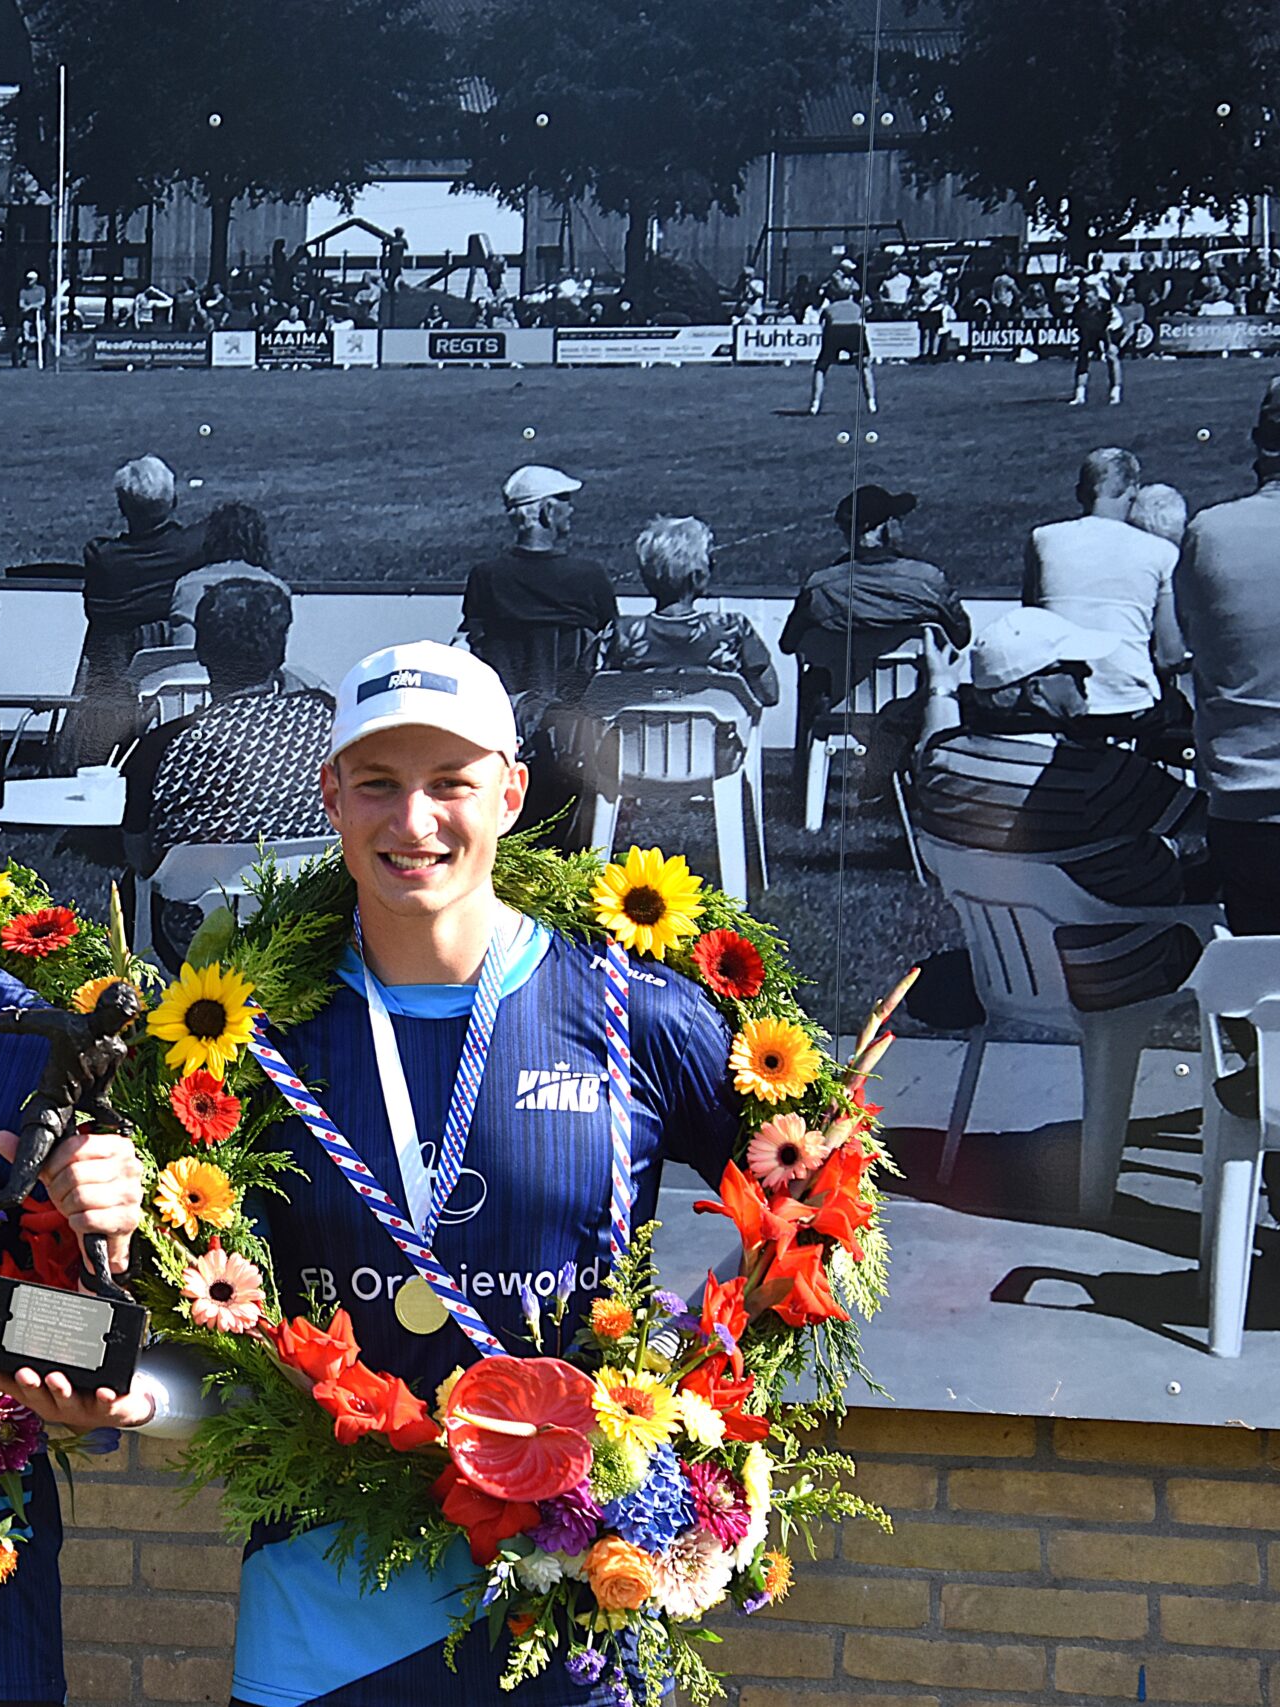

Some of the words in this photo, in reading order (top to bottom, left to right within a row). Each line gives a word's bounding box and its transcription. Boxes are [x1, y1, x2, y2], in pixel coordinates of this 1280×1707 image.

[261, 332, 328, 346] HAAIMA
[436, 338, 499, 354] REGTS
[972, 329, 1034, 346] DIJKSTRA
[514, 1069, 601, 1113] KNKB
[300, 1267, 337, 1300] FB
